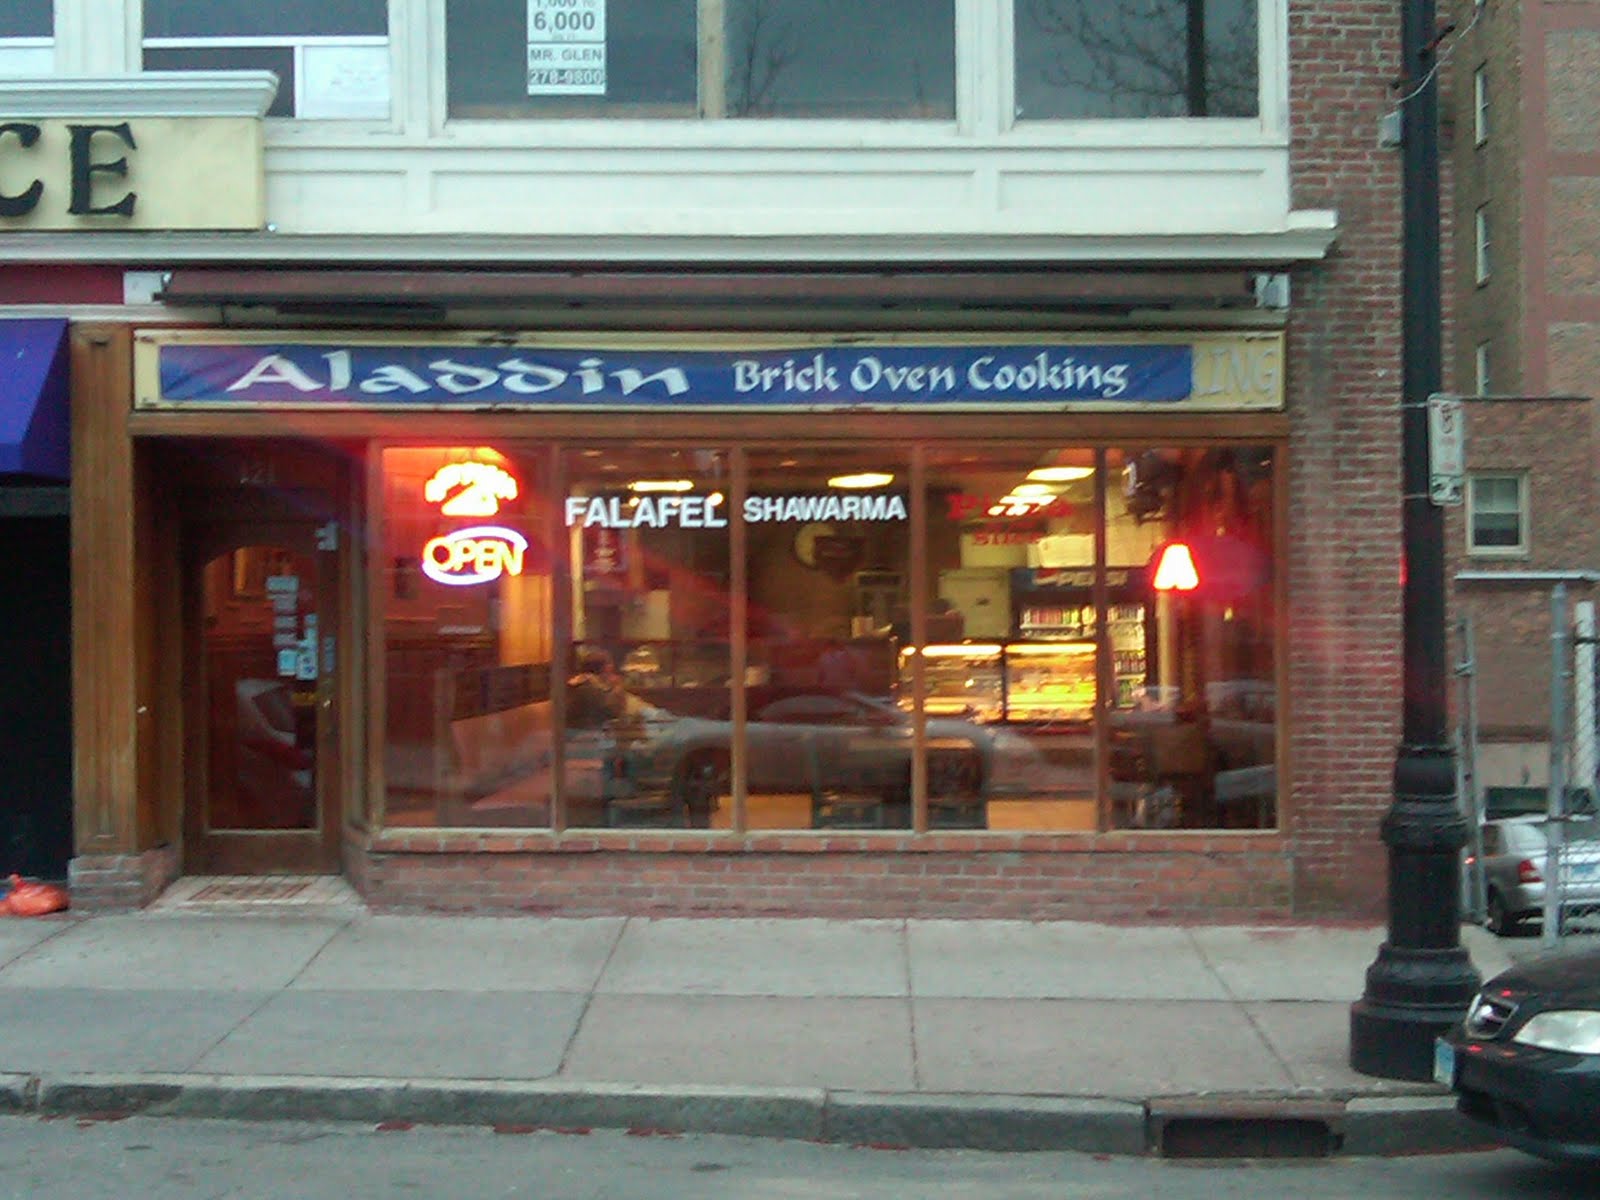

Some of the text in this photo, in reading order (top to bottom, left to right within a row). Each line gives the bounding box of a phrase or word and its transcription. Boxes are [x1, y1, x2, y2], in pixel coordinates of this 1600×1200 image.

[533, 11, 596, 33] 6,000
[560, 48, 603, 61] GLEN
[0, 122, 138, 217] CE
[226, 350, 1129, 398] Aladdin Brick Oven Cooking
[564, 495, 909, 529] FALAFEL SHAWARMA
[422, 536, 524, 577] OPEN
